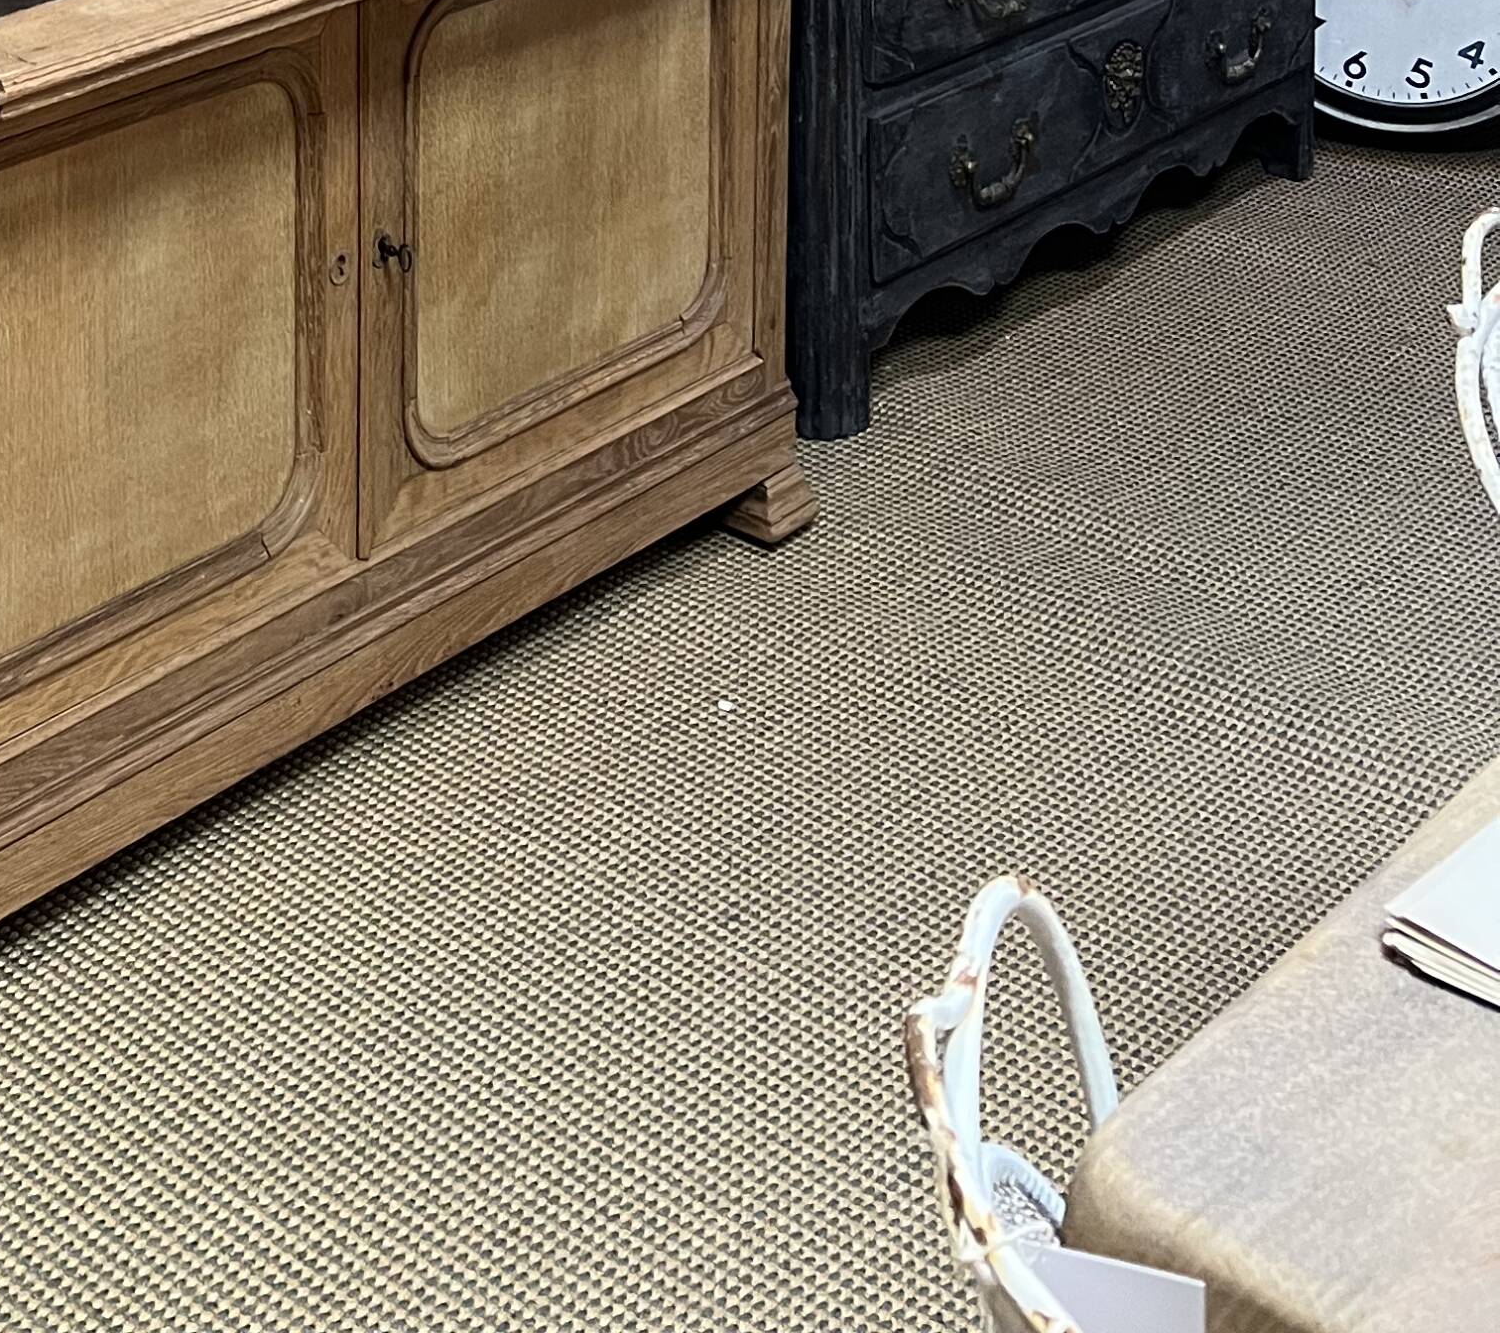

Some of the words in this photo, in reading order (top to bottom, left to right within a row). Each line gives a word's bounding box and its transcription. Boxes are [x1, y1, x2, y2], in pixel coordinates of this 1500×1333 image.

[1343, 50, 1368, 80] 6
[1457, 40, 1486, 70] 4
[1405, 57, 1434, 89] 5
